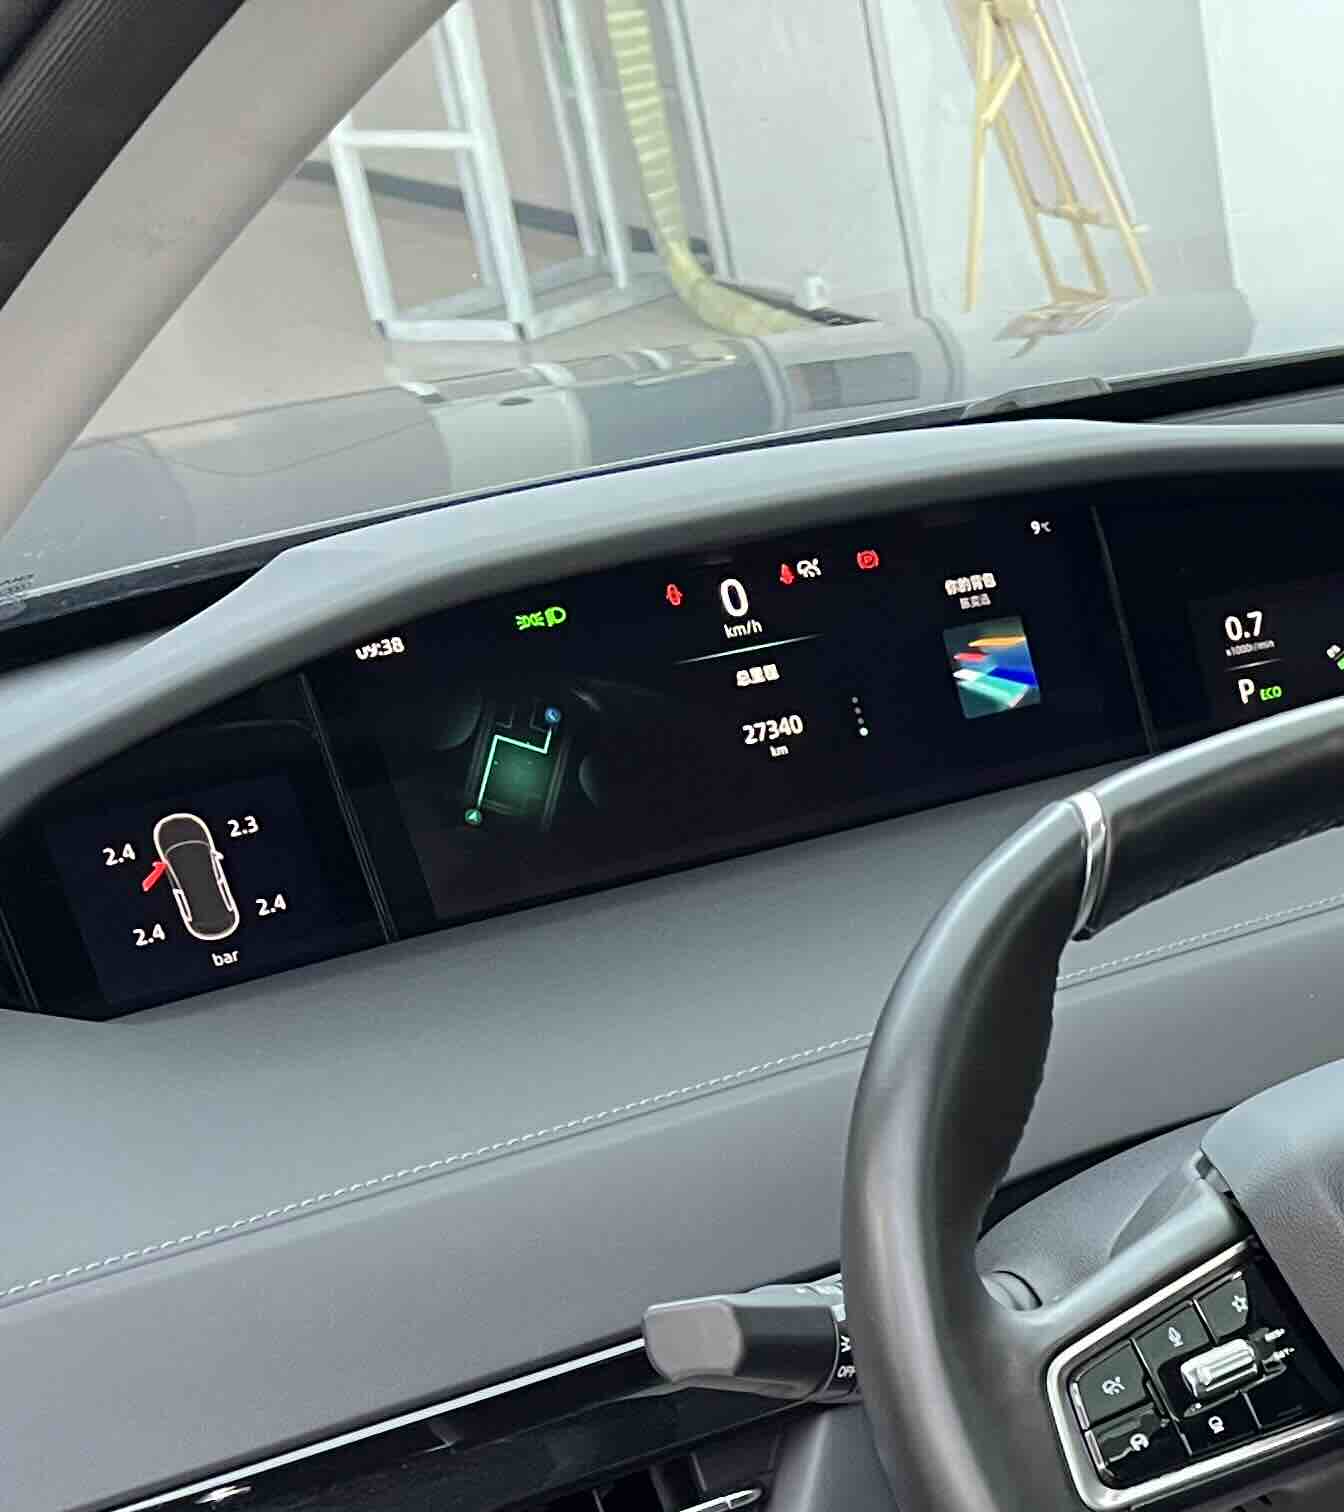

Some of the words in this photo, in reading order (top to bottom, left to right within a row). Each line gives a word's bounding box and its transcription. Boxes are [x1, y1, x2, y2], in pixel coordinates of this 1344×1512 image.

[720, 578, 749, 617] 0
[723, 614, 763, 639] km/h
[1224, 610, 1263, 642] 0.7
[1237, 678, 1255, 705] P
[1259, 685, 1283, 702] ECO
[741, 714, 804, 745] 27340
[226, 815, 259, 838] 2.3
[102, 842, 136, 866] 2.4
[255, 893, 287, 916] 2.4
[132, 923, 166, 947] 2.4
[211, 950, 239, 967] bar
